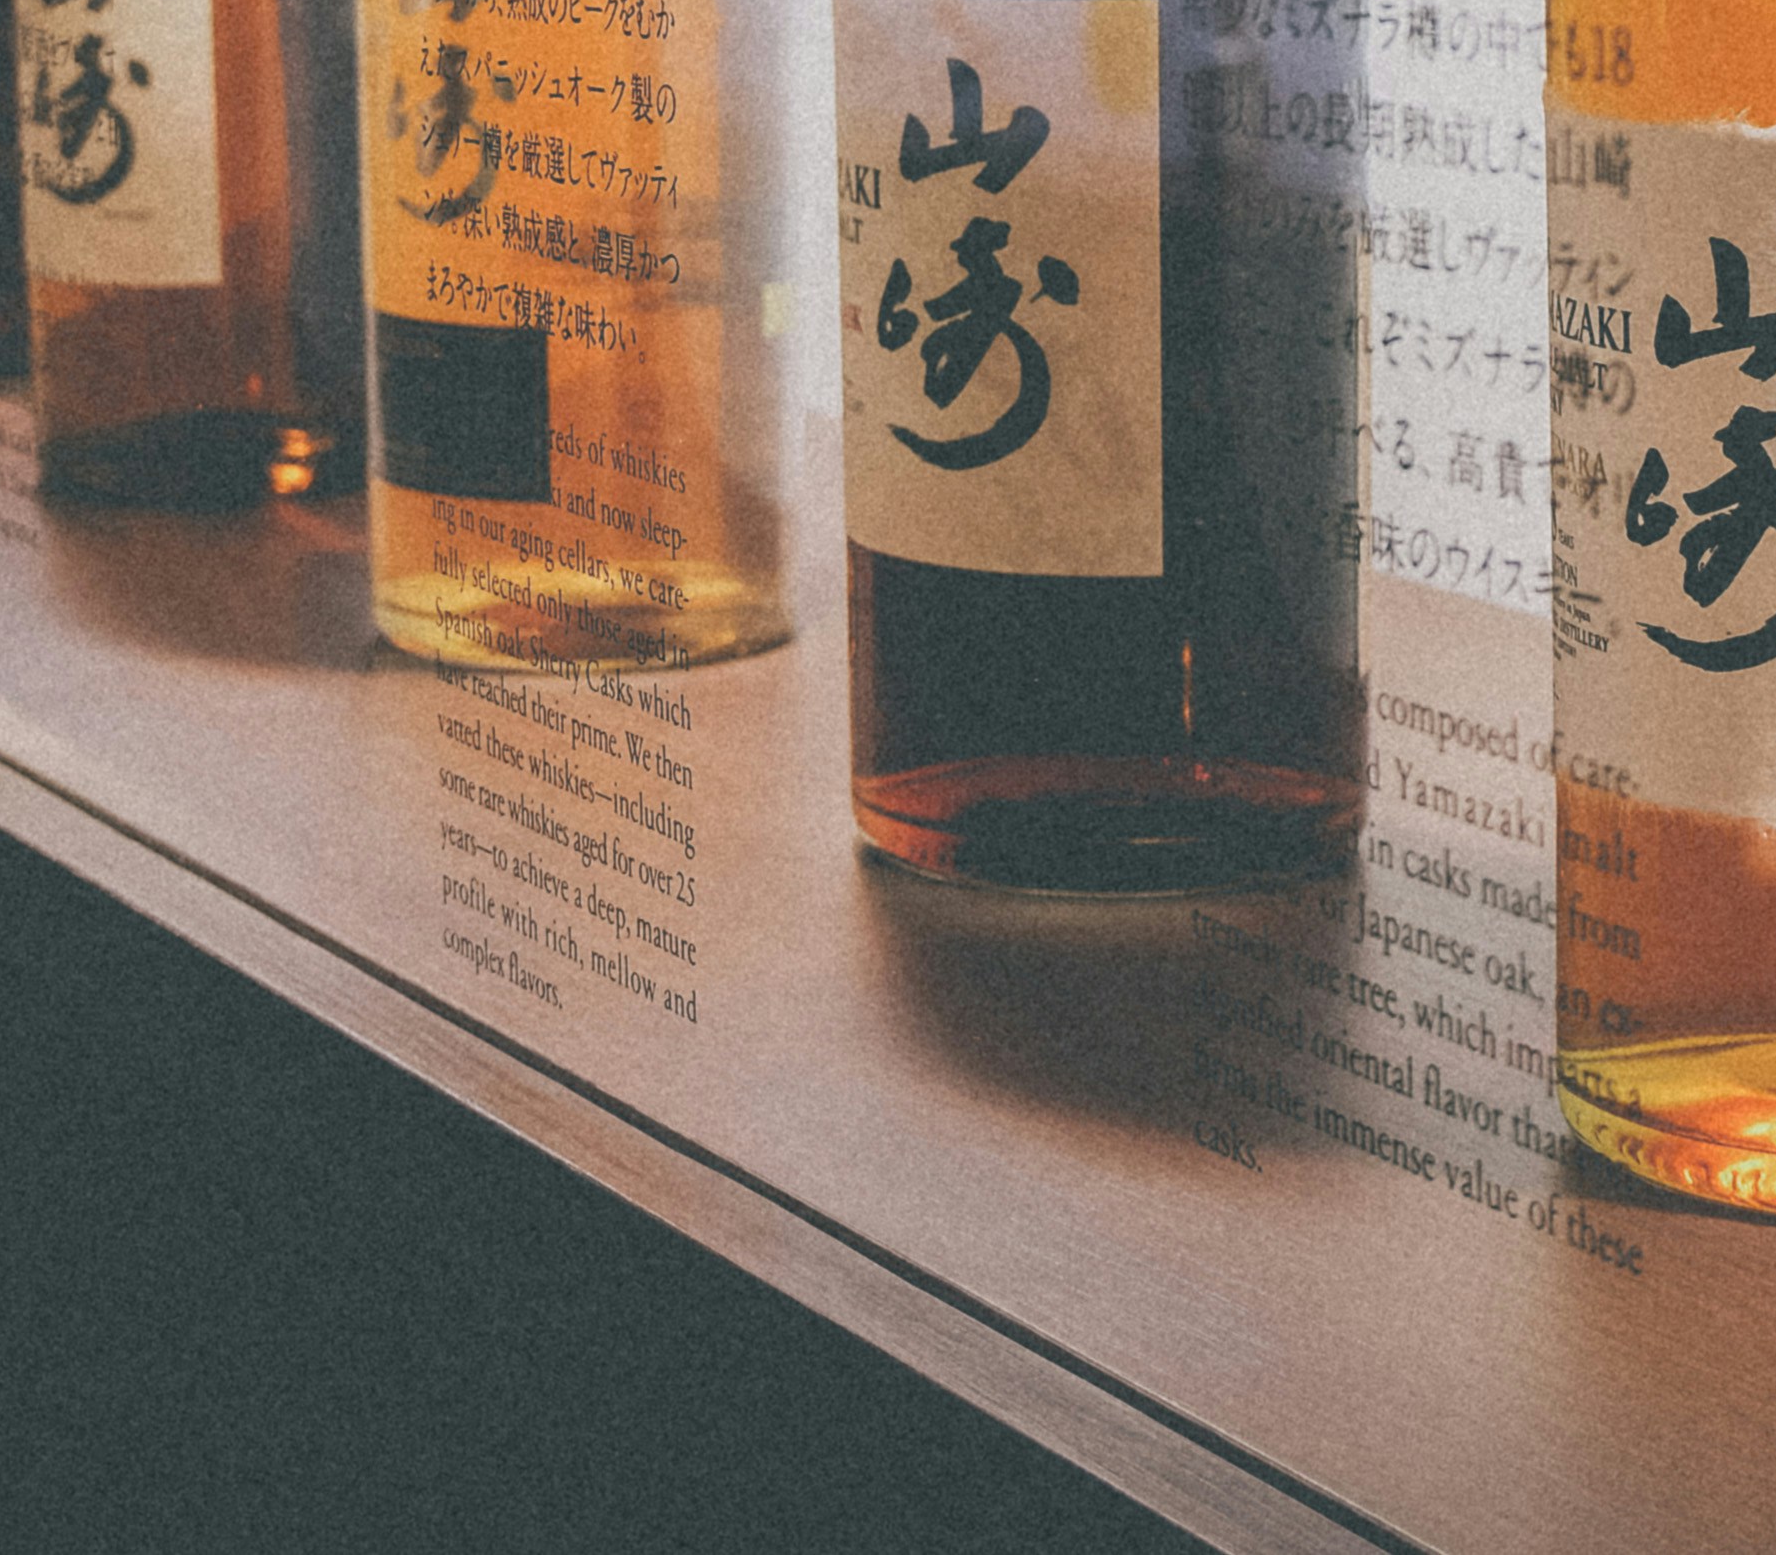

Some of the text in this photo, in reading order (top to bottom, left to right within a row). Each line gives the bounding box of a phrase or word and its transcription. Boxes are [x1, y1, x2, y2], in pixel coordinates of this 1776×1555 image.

[421, 36, 677, 124] えたスパニッシュオーク製の
[421, 115, 678, 209] シェリー樽を厳選してヴァッティ
[427, 259, 646, 364] まろやかで複雑な味わい。
[877, 57, 1080, 471] 山崎
[588, 433, 607, 467] of
[612, 441, 686, 494] whiskies
[433, 498, 690, 612] ing in our aging cellars, we care-
[568, 488, 596, 521] and
[601, 504, 635, 534] now
[640, 507, 687, 561] sleep-
[434, 541, 690, 672] fully selected only those aged in
[435, 596, 692, 731] Spanish oak Sherry Casks which
[436, 650, 693, 790] have reached their prime. We then
[438, 713, 481, 751] vatted
[486, 727, 524, 770] these
[1376, 691, 1641, 799] composed of care-
[439, 767, 695, 907] some rare whiskies aged for over 25
[1395, 756, 1546, 849] Yamazaki
[1562, 827, 1639, 883] malt
[512, 852, 569, 903] achieve
[574, 887, 582, 909] a
[587, 884, 632, 939] deep,
[636, 917, 697, 967] mature
[1353, 891, 1475, 976] Japanese
[1484, 951, 1545, 1003] oak,
[1368, 821, 1642, 961] in casks made from
[442, 874, 698, 1024] profile with rich, mellow and
[443, 927, 563, 1010] complex flavors.
[1348, 971, 1406, 1028] tree,
[1413, 995, 1498, 1070] which
[1192, 1120, 1264, 1174] casks.
[1312, 1028, 1414, 1099] oriental
[1423, 1062, 1504, 1137] flavor
[1511, 1103, 1569, 1162] that
[1313, 1090, 1435, 1182] immense
[1443, 1159, 1520, 1220] value
[1527, 1194, 1560, 1237] of
[1566, 1205, 1644, 1276] these
